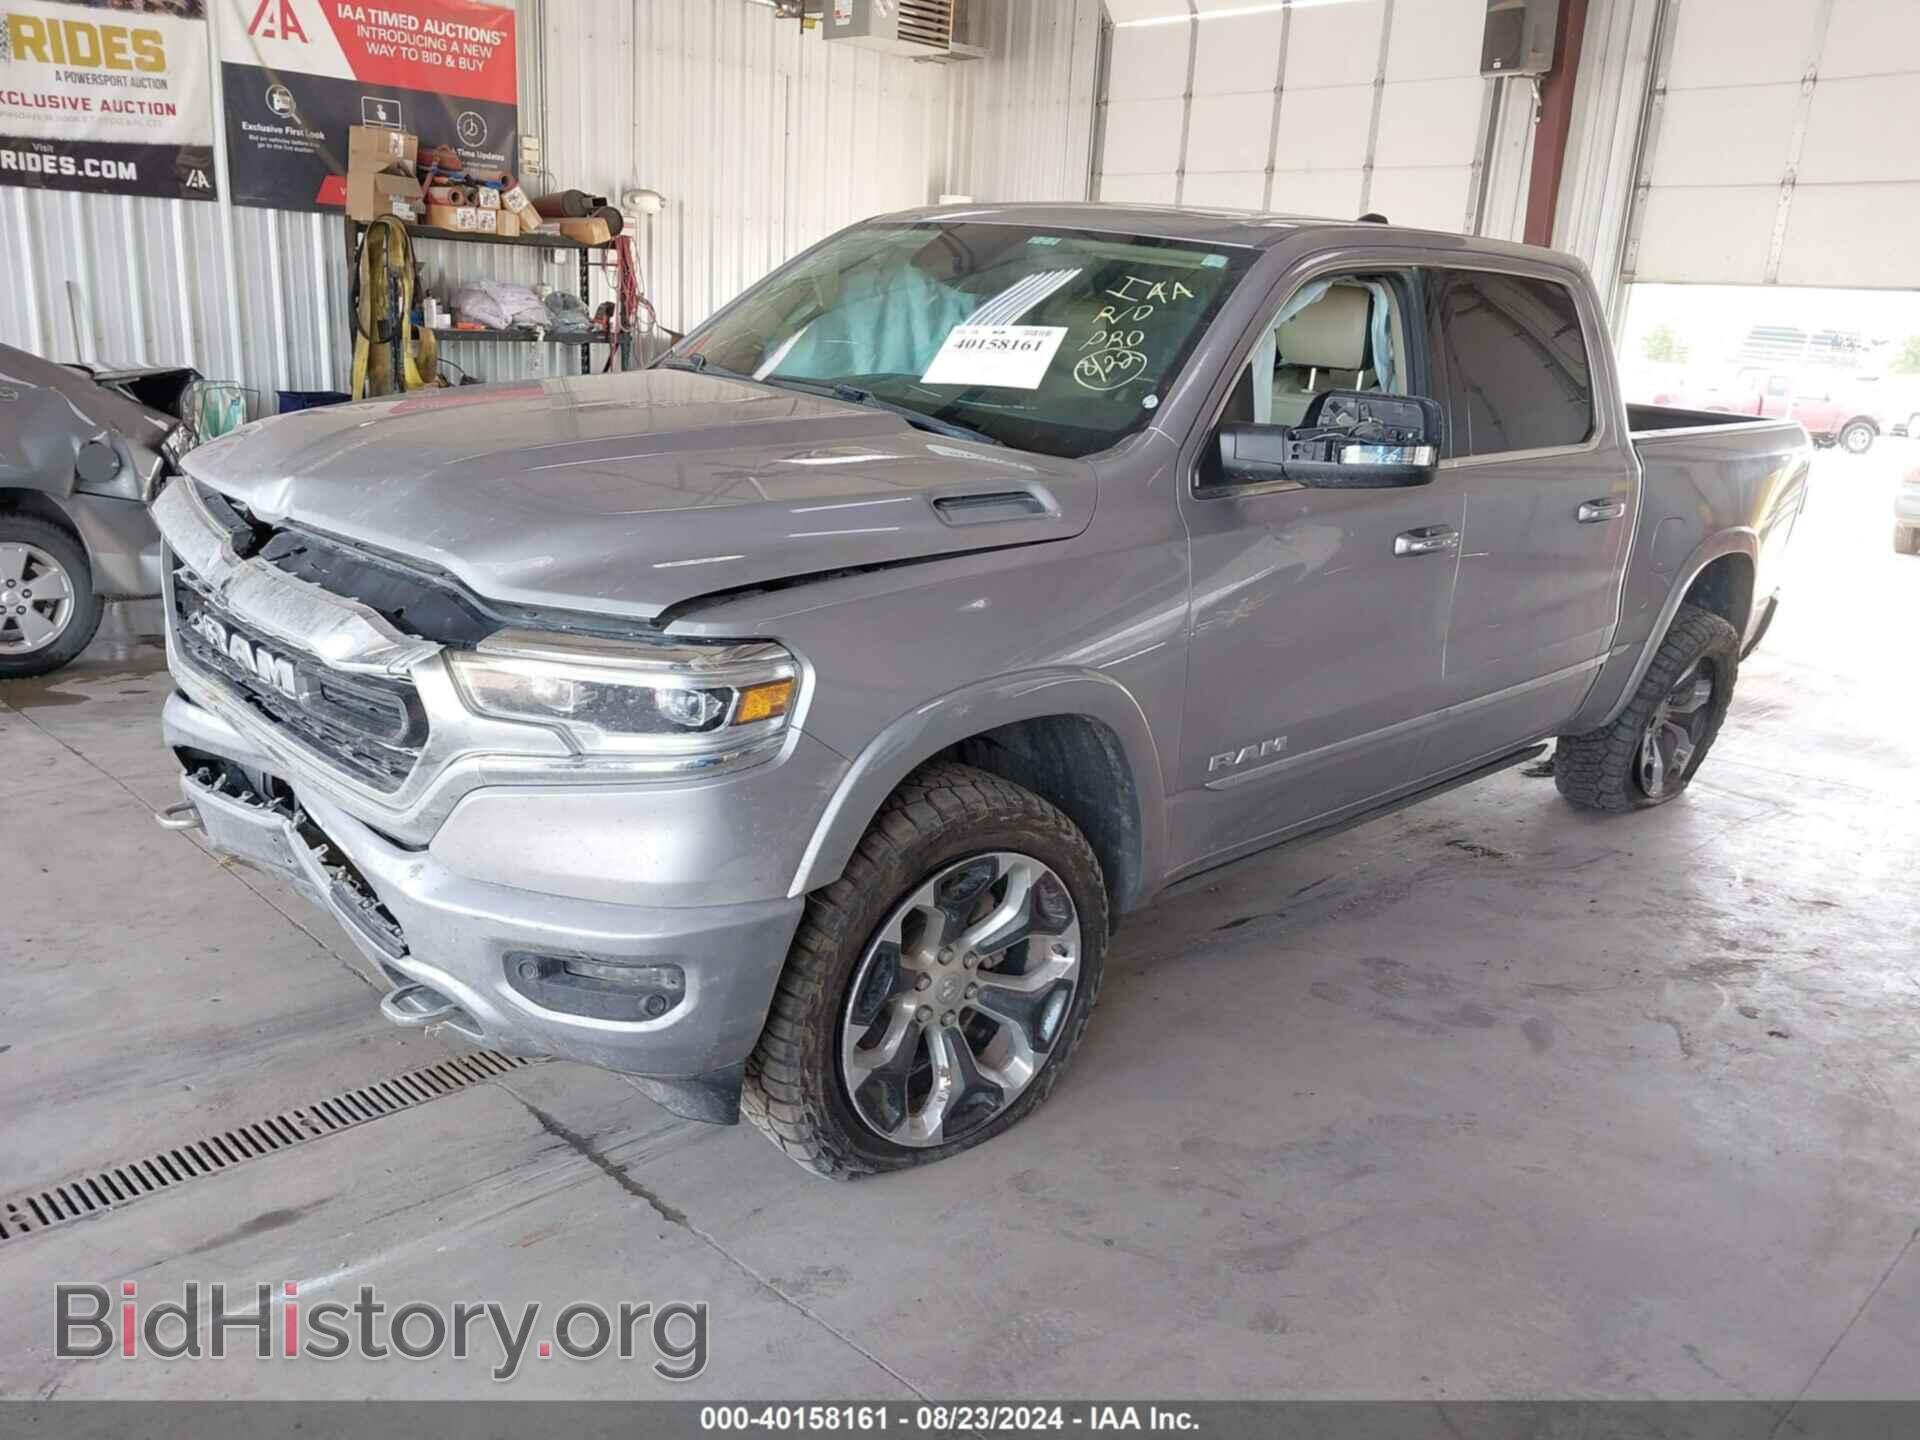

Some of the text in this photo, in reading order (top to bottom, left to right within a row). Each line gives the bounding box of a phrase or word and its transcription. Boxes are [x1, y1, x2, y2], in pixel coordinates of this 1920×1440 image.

[337, 3, 367, 21] IAA
[368, 9, 419, 30] TIMED
[7, 13, 167, 73] RIDES
[357, 24, 493, 59] INTRODUCING A NEW
[366, 41, 485, 72] WAY TO BID & BUY
[55, 70, 168, 90] A POWERSPORT AUCTION
[100, 99, 177, 117] AUCTION
[241, 121, 284, 134] Exclusive
[285, 126, 305, 137] First
[32, 142, 54, 154] Visit
[476, 151, 505, 161] Updates
[1, 149, 137, 181] RIDES.COM
[953, 338, 1043, 352] 40158161
[202, 613, 306, 700] RAM
[1208, 735, 1288, 771] RAM
